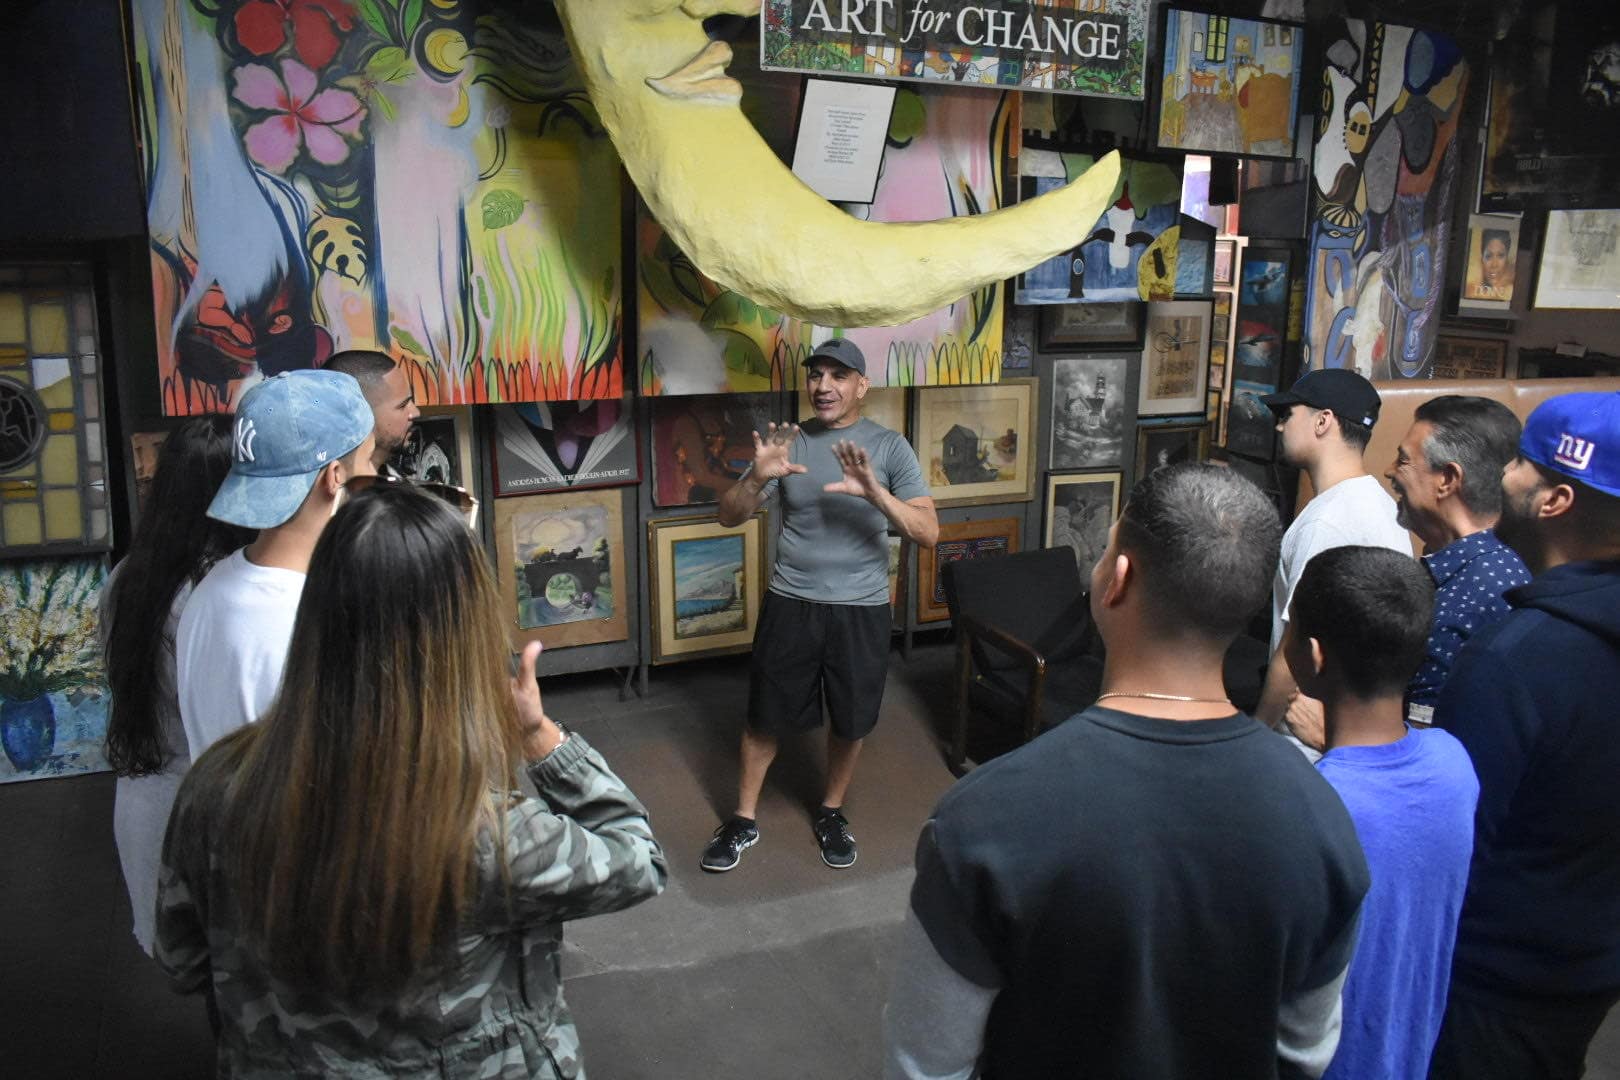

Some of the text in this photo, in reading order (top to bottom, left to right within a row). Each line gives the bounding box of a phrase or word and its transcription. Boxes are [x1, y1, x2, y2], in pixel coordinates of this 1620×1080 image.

[801, 0, 1121, 60] ART for CHANGE
